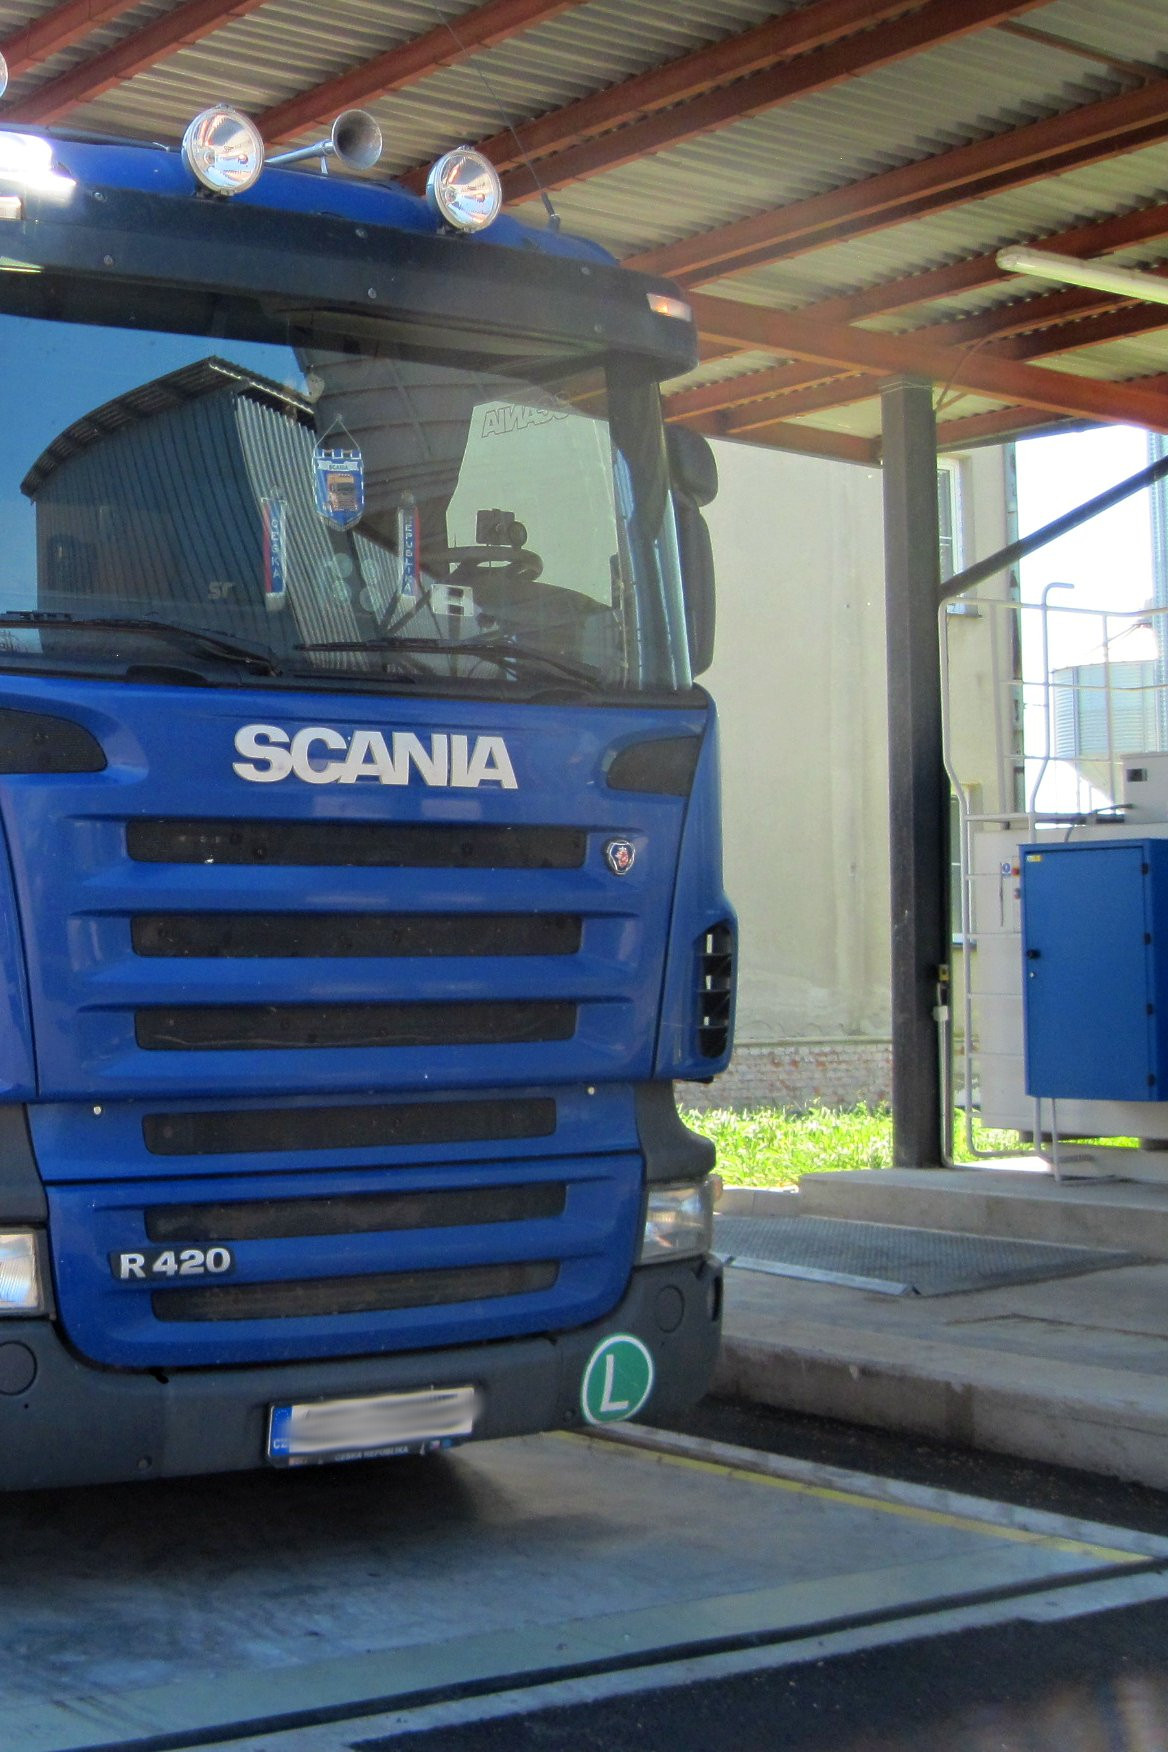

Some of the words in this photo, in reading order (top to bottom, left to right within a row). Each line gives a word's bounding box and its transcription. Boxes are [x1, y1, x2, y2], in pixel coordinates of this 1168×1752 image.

[232, 724, 519, 789] SCANIA
[120, 1253, 146, 1279] R
[152, 1247, 231, 1277] 420
[600, 1354, 630, 1412] L
[272, 1437, 289, 1449] CZ
